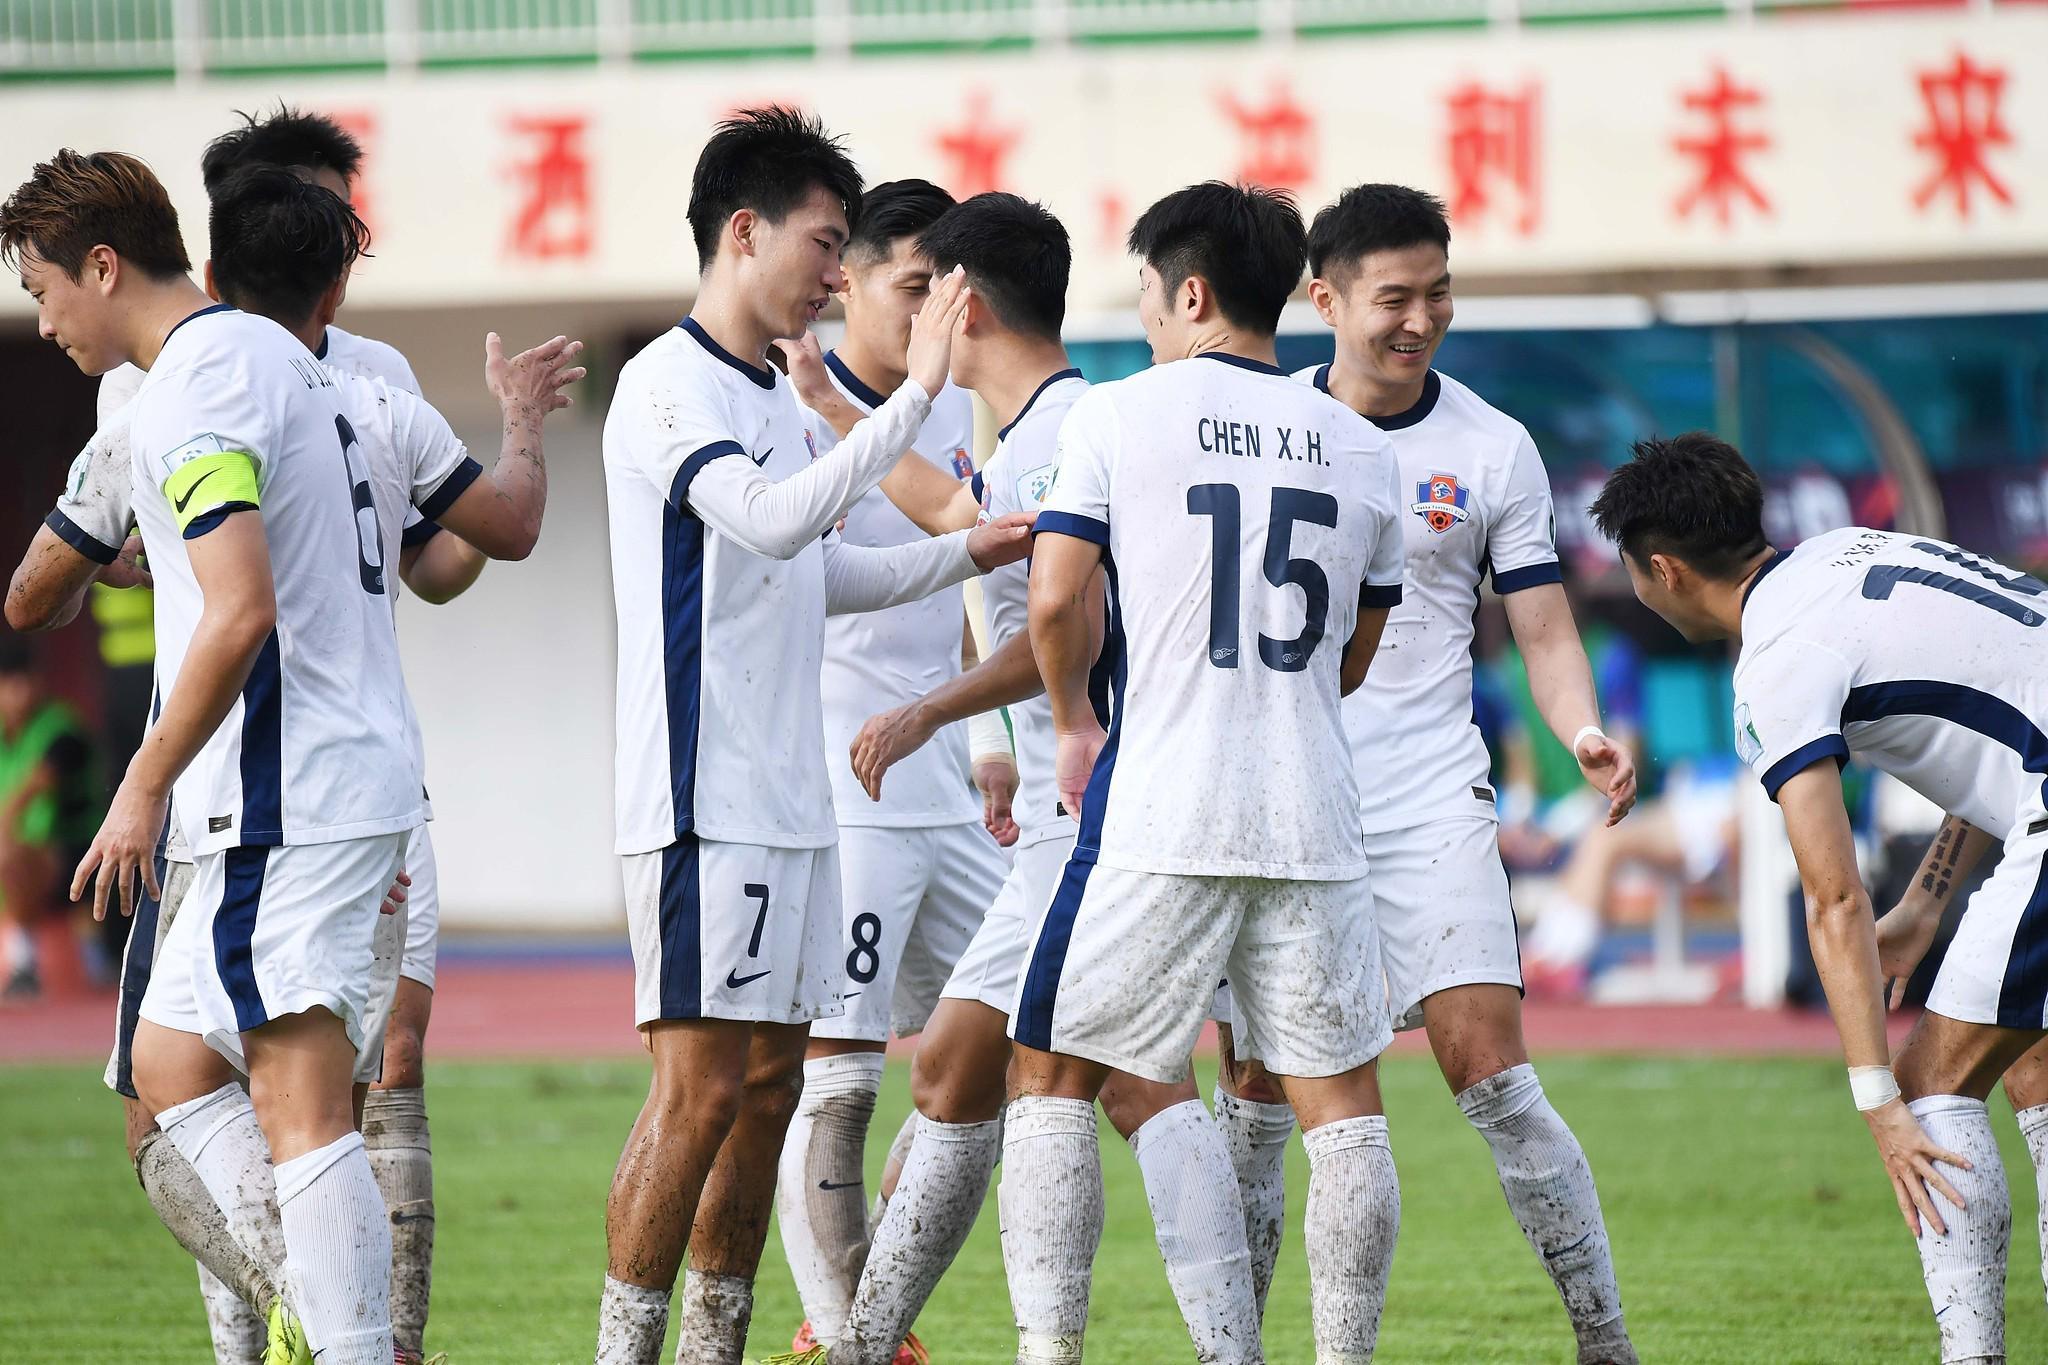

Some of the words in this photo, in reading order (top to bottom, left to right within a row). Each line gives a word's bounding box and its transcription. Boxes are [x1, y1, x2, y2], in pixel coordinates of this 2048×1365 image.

[1198, 417, 1261, 458] CHEN
[1276, 427, 1330, 467] X.H.
[1187, 483, 1338, 672] 15
[744, 883, 769, 958] 7
[846, 912, 882, 984] 8
